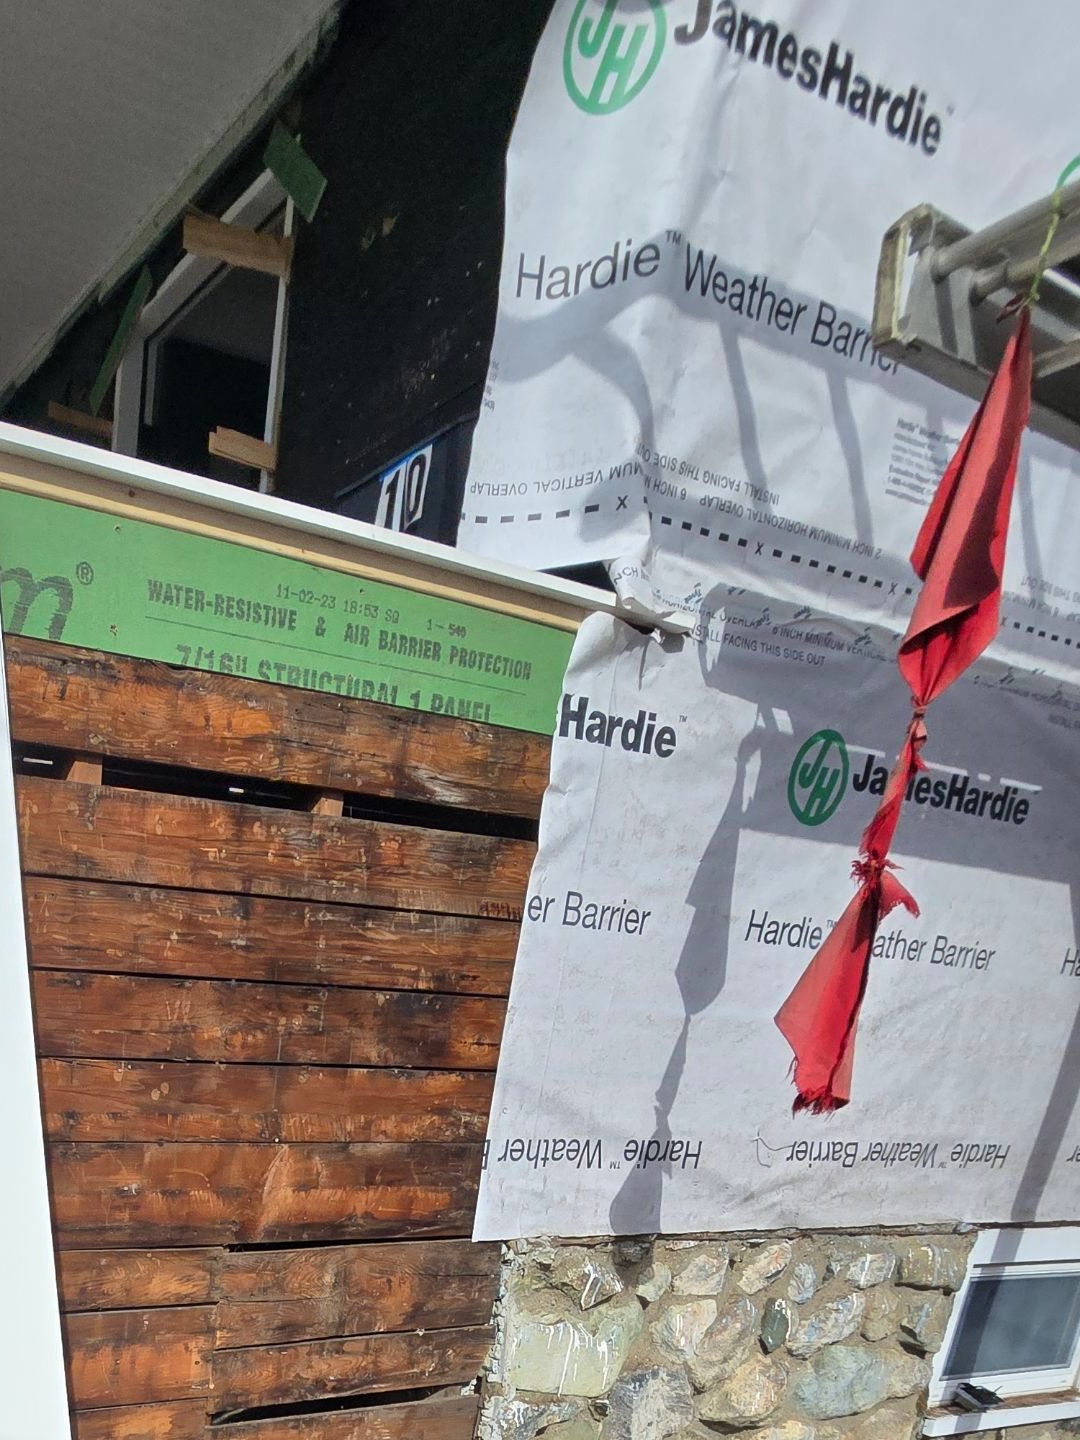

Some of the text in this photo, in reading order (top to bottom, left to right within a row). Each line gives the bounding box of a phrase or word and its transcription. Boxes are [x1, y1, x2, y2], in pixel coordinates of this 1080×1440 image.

[673, 0, 942, 156] JamesHardie
[685, 242, 808, 336] Weather
[810, 301, 899, 376] Barr
[653, 452, 677, 472] SIDE
[679, 461, 700, 481] THIS
[383, 453, 428, 532] 10
[471, 480, 527, 496] OVERLAP
[534, 471, 603, 493] VERTICAL
[653, 479, 677, 497] INCH
[680, 486, 687, 500] 6
[702, 469, 740, 492] FACING
[745, 481, 780, 505] INSTALL
[699, 494, 744, 519] OVERLAP
[747, 508, 808, 537] HORIZONTAL
[808, 526, 852, 551] MINIMUM
[853, 540, 874, 558] INCH
[874, 549, 882, 560] 2
[276, 583, 336, 610] 11-02-23
[344, 599, 379, 620] 18:53
[147, 579, 532, 681] WATER-RESISTIVE & AIR BARRIER PROTECTION
[780, 624, 802, 641] INCH
[805, 631, 845, 652] MINIMUM
[724, 633, 757, 653] FACING
[761, 641, 780, 658] THIS
[783, 647, 804, 662] SIDE
[807, 651, 825, 667] OUT
[562, 890, 651, 936] Barrier
[871, 930, 927, 963] ather
[931, 935, 996, 971] Barrier
[497, 1138, 602, 1169] Weather
[786, 1140, 858, 1168] Barrier
[862, 1143, 938, 1168] Weather
